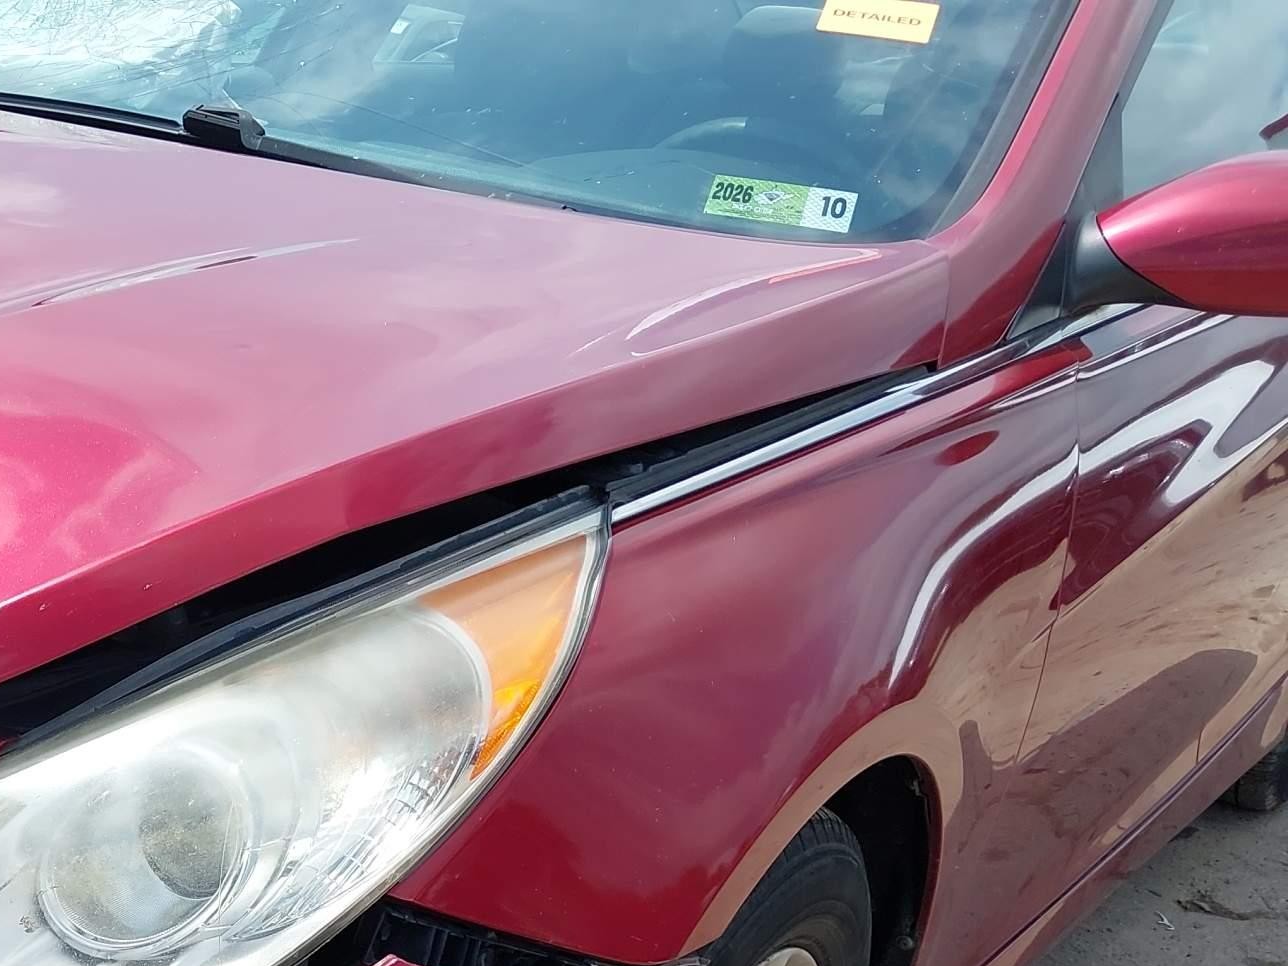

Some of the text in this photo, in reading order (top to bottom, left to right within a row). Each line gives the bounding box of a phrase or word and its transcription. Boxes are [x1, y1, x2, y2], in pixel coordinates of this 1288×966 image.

[833, 8, 921, 26] DETAILED
[712, 182, 754, 204] 2026
[821, 196, 847, 219] 10
